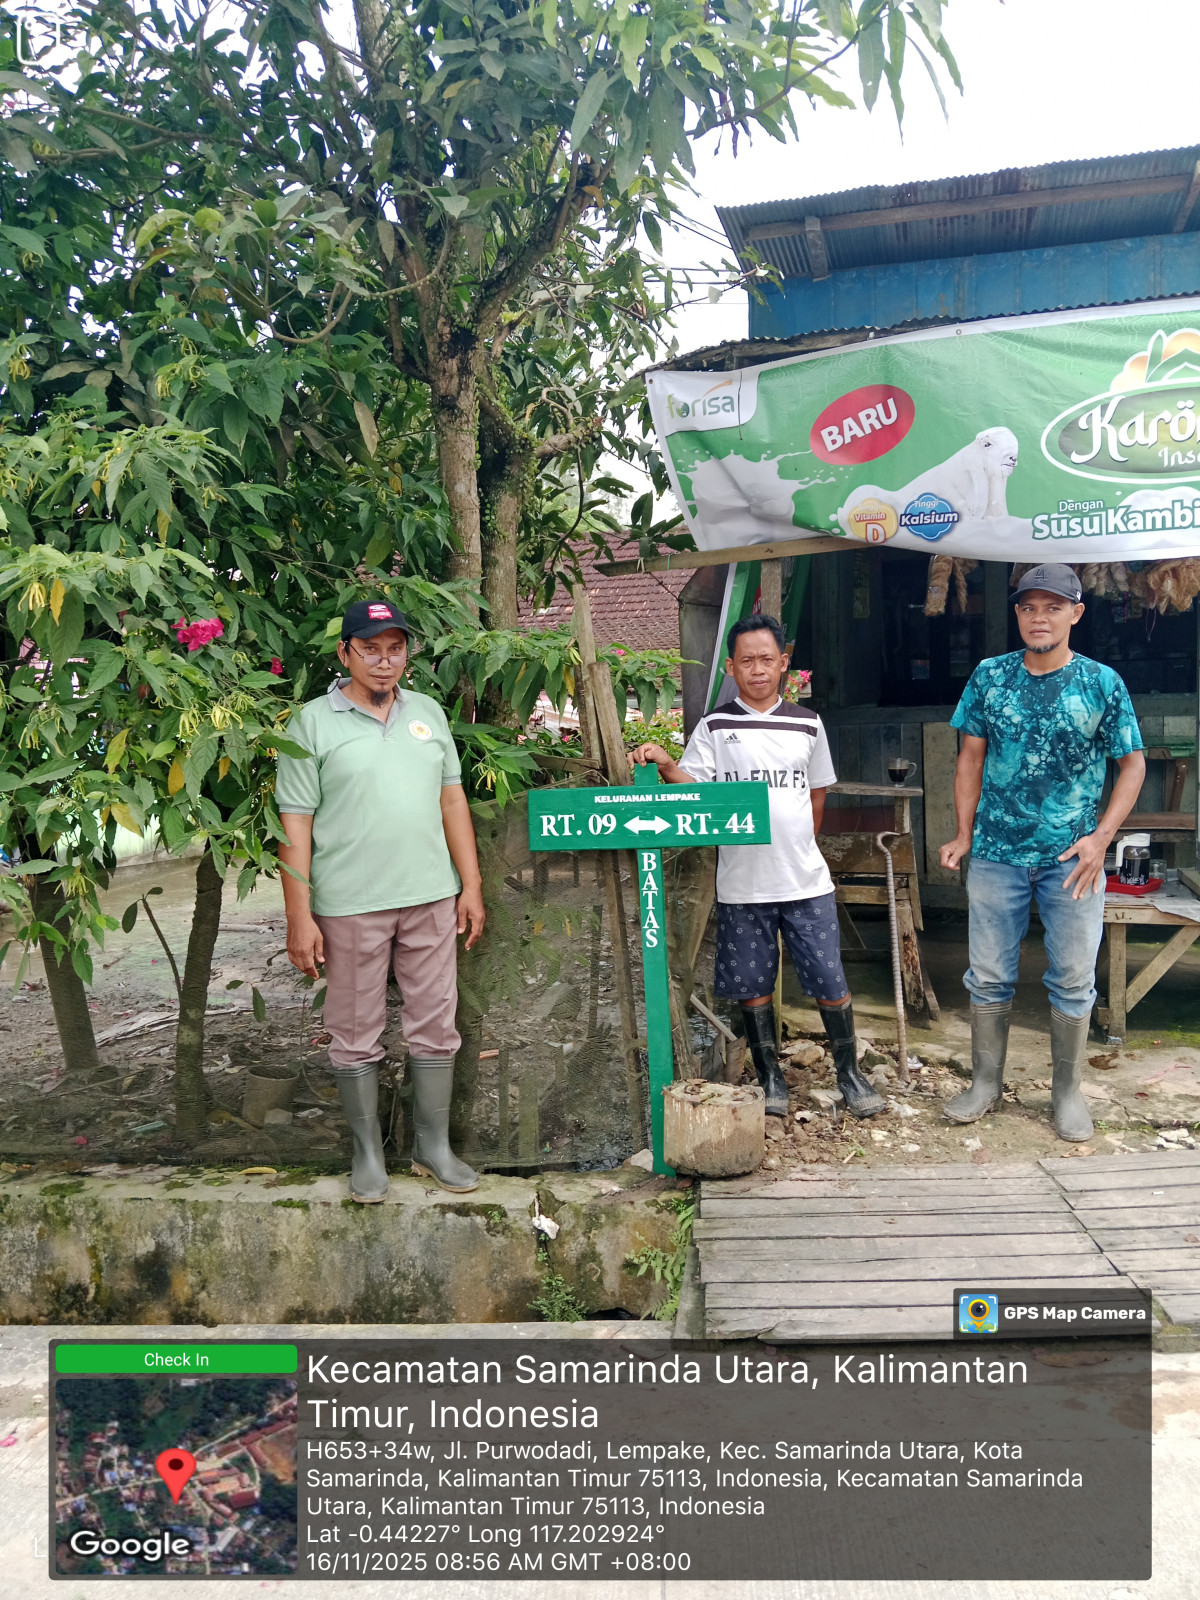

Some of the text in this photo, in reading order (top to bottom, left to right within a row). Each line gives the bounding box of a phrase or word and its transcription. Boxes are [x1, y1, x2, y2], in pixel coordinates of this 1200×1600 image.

[667, 392, 735, 419] forisa
[820, 397, 899, 452] BARU
[914, 498, 939, 509] Tinggi
[1059, 498, 1104, 513] Dengan
[854, 512, 886, 522] Vitamin
[900, 511, 959, 527] Kalsium
[1032, 514, 1103, 540] Susu
[865, 521, 887, 544] D
[594, 793, 701, 804] KELURAHAN LEMPAKE
[540, 812, 756, 837] RT. 09 RT. 44
[641, 852, 660, 948] BATAS
